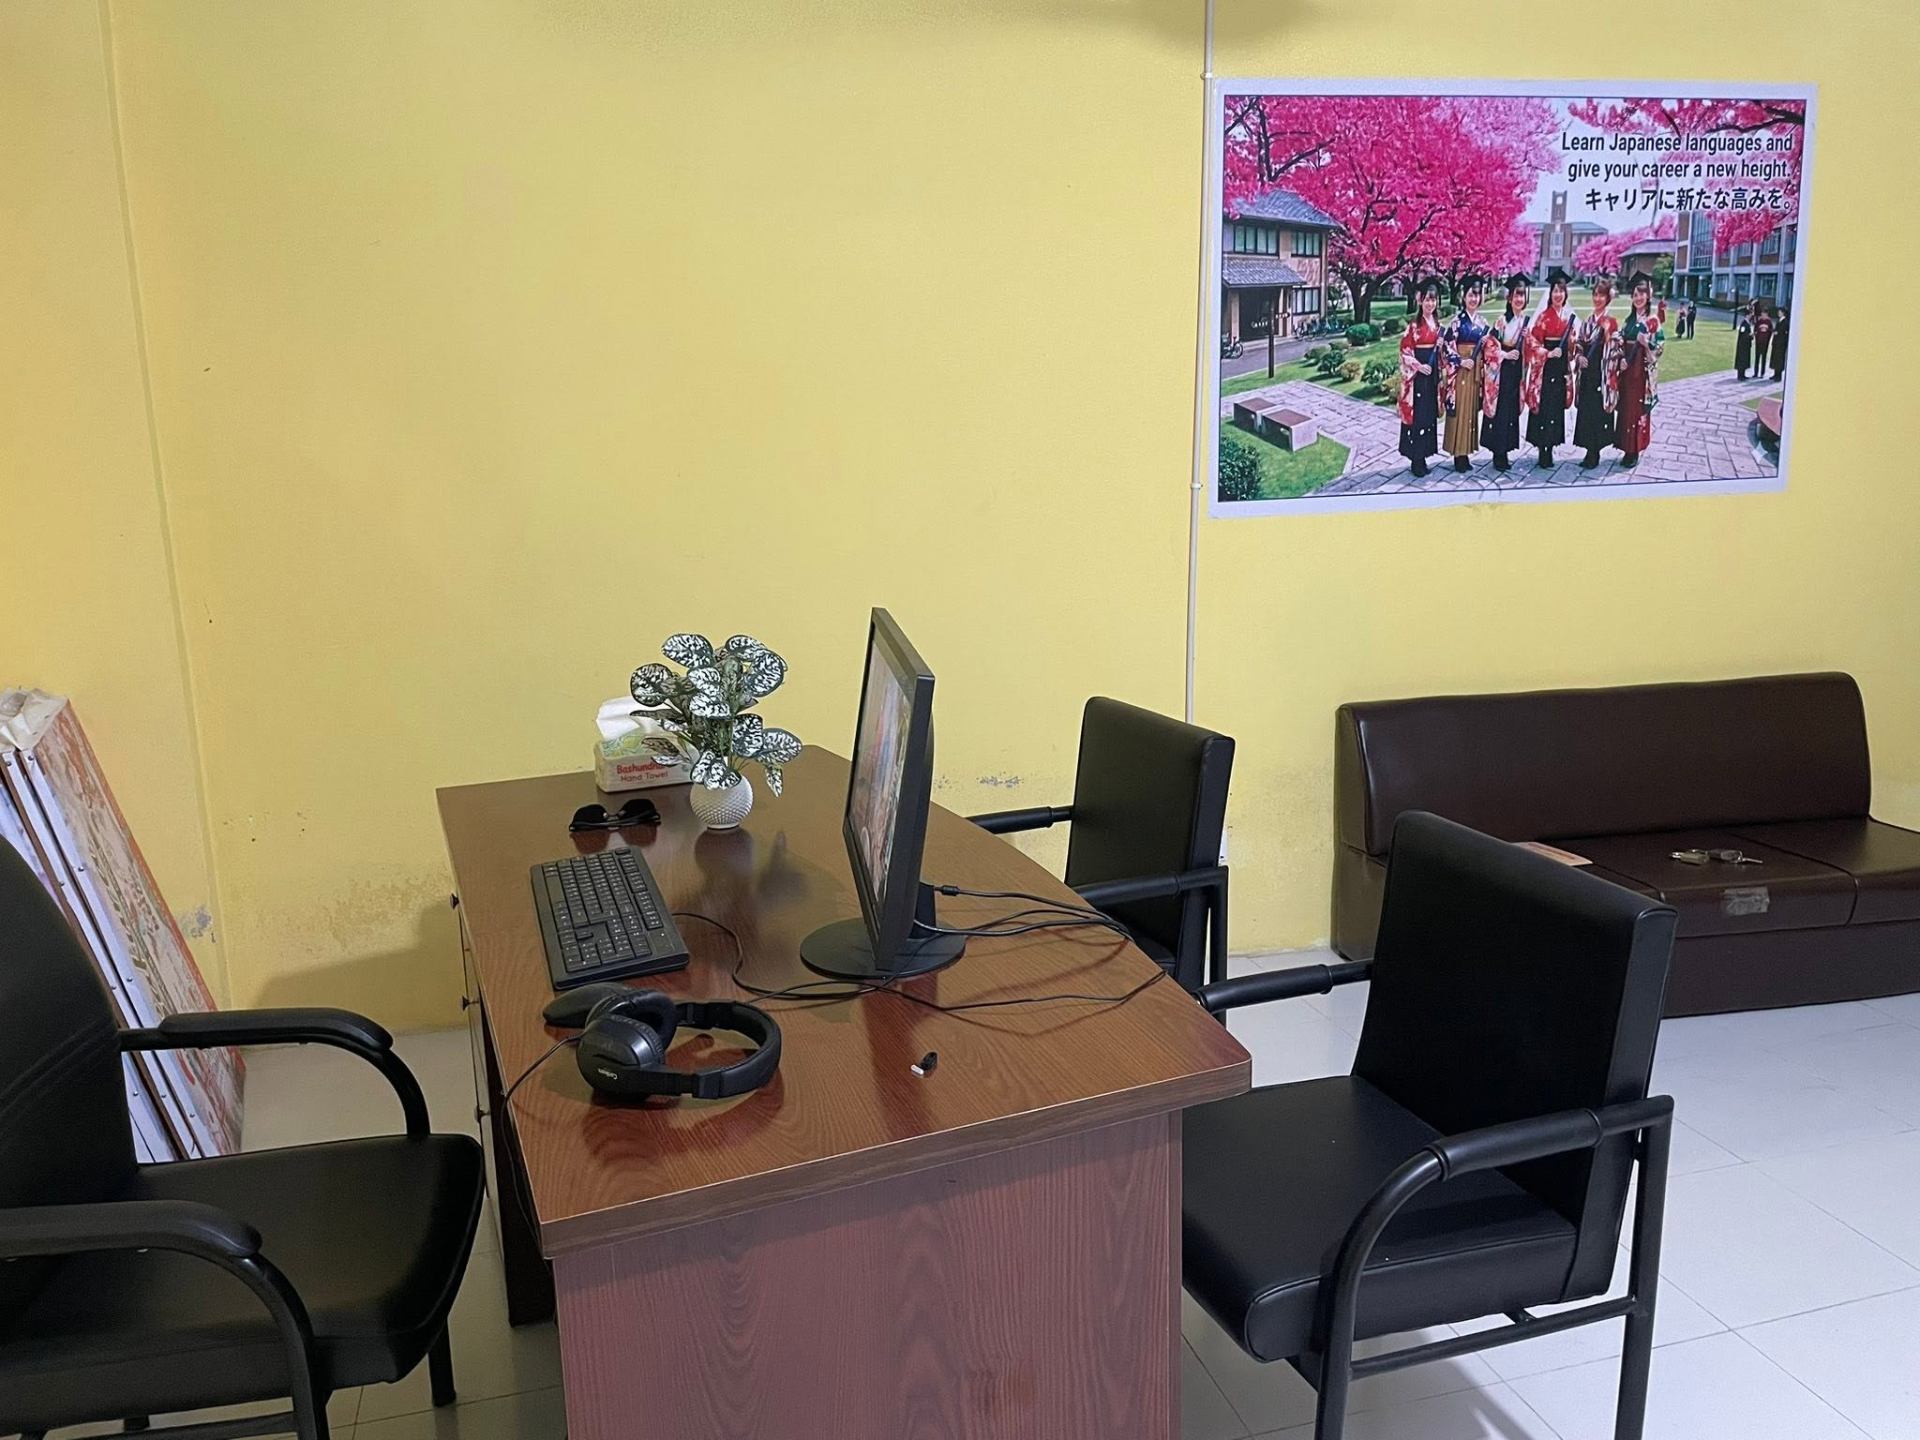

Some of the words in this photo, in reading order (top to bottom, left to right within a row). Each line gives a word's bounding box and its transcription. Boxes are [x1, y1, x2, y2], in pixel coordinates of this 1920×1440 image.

[1562, 131, 1605, 151] Learn
[1609, 133, 1681, 155] Japanese
[1685, 132, 1762, 156] languages
[1766, 134, 1793, 151] and
[1568, 159, 1600, 182] give
[1604, 163, 1638, 182] your
[1641, 162, 1688, 178] career
[1693, 163, 1701, 178] a
[1706, 162, 1737, 178] new
[1741, 159, 1791, 181] height.
[1585, 187, 1791, 212] キャリアに新たな高みを。
